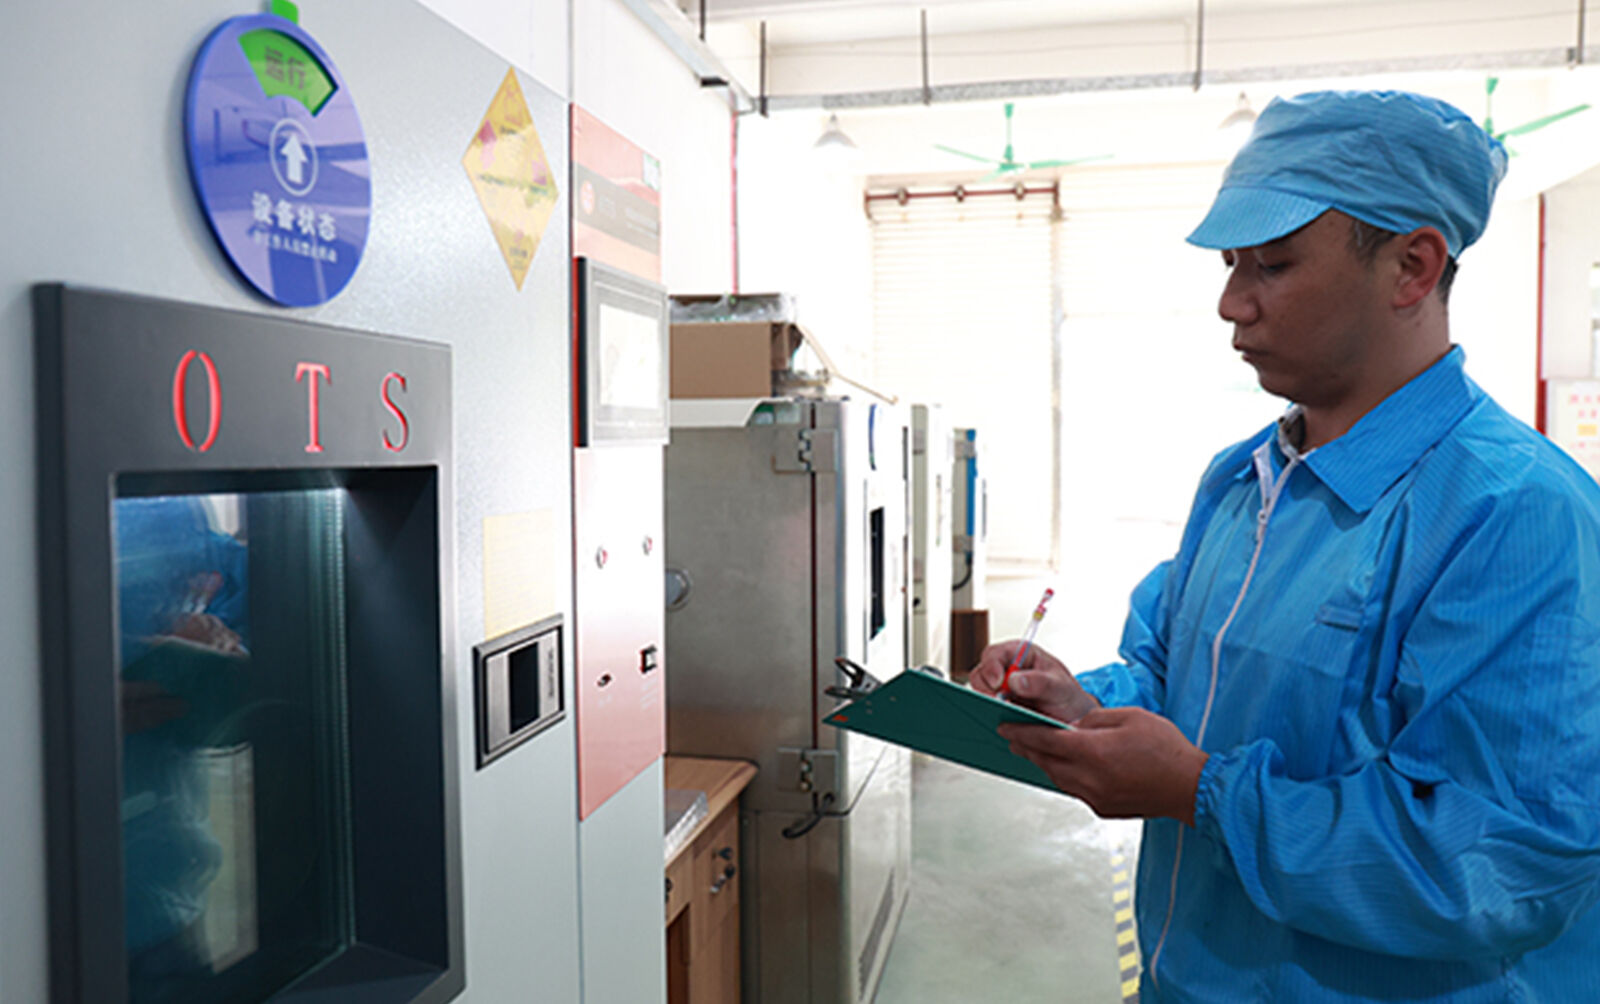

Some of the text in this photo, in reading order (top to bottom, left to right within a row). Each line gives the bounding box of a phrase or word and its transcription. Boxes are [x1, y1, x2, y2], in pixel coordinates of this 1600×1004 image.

[252, 191, 336, 241] 设备状态
[173, 349, 408, 452] OTS
